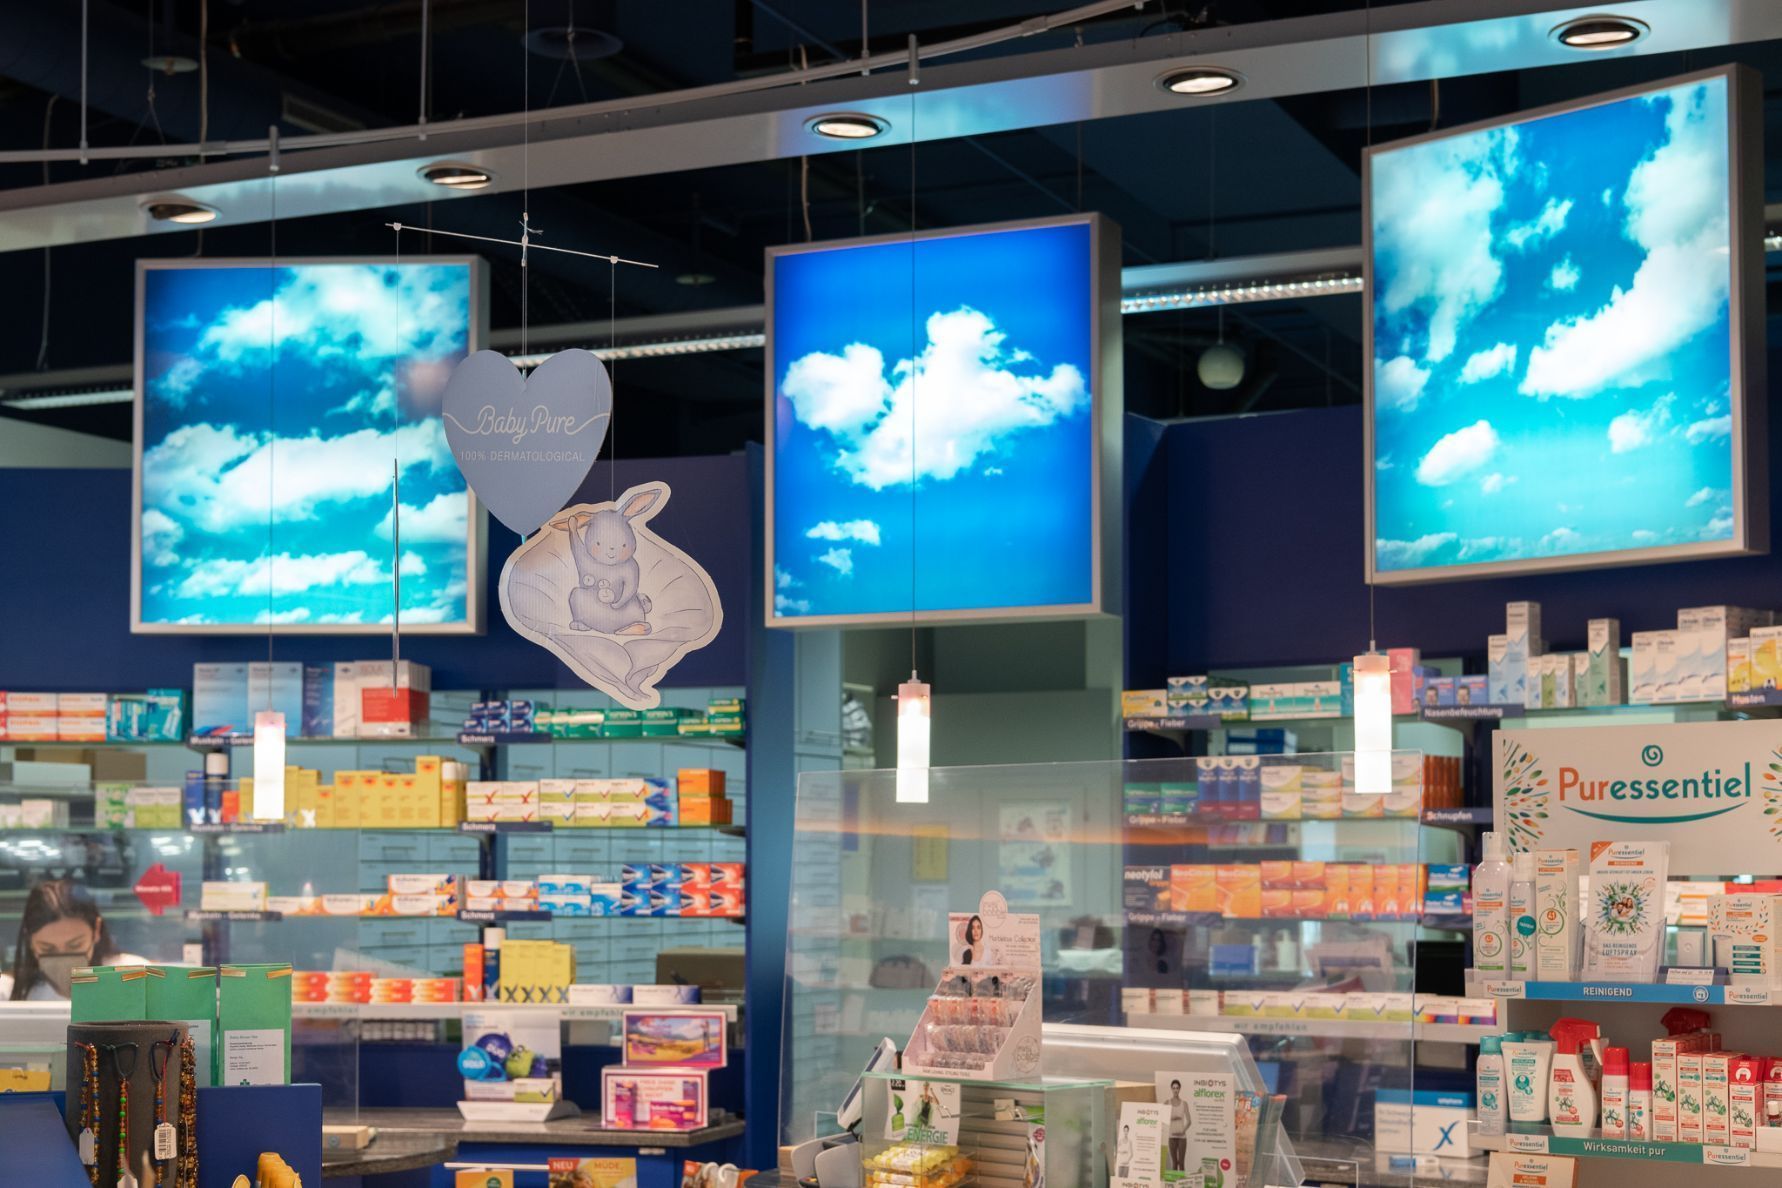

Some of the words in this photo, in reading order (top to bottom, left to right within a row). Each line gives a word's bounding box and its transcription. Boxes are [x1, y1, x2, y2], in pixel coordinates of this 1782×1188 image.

[477, 405, 529, 444] Baby
[530, 405, 575, 436] Pure
[461, 451, 486, 462] 100%
[490, 450, 585, 463] DERMATOLOGICAL
[1732, 693, 1766, 705] Husten
[1424, 705, 1503, 719] Nasenbefeuchtung
[1127, 719, 1154, 729] Grippe
[1160, 718, 1186, 727] Fieber
[461, 734, 495, 744] Schmerz
[1558, 761, 1751, 801] Puressentiel
[1129, 815, 1156, 825] Grippe
[1162, 814, 1187, 824] Fieber
[1427, 811, 1473, 822] Schnupfen
[462, 822, 496, 832] Schmerz
[1608, 848, 1645, 856] Puressentiel
[461, 911, 495, 920] Schmerz
[1128, 913, 1154, 922] Grippe
[1486, 984, 1522, 993] Puressentiel
[1583, 986, 1633, 998] REINIGEND
[1728, 991, 1768, 1000] Puressentiel
[1234, 1023, 1249, 1031] wir
[1252, 1022, 1308, 1034] empfehlen
[1194, 1079, 1227, 1088] INBIOTYS
[1193, 1088, 1225, 1098] alflorex
[907, 1127, 949, 1145] ENERGIE
[1509, 1138, 1545, 1148] Puressentiel
[1583, 1141, 1646, 1155] Wirksamkeit
[1648, 1147, 1666, 1157] pur
[1706, 1151, 1747, 1161] Puressentiel
[553, 1161, 574, 1170] NEU
[1514, 1161, 1549, 1170] Puressentiel
